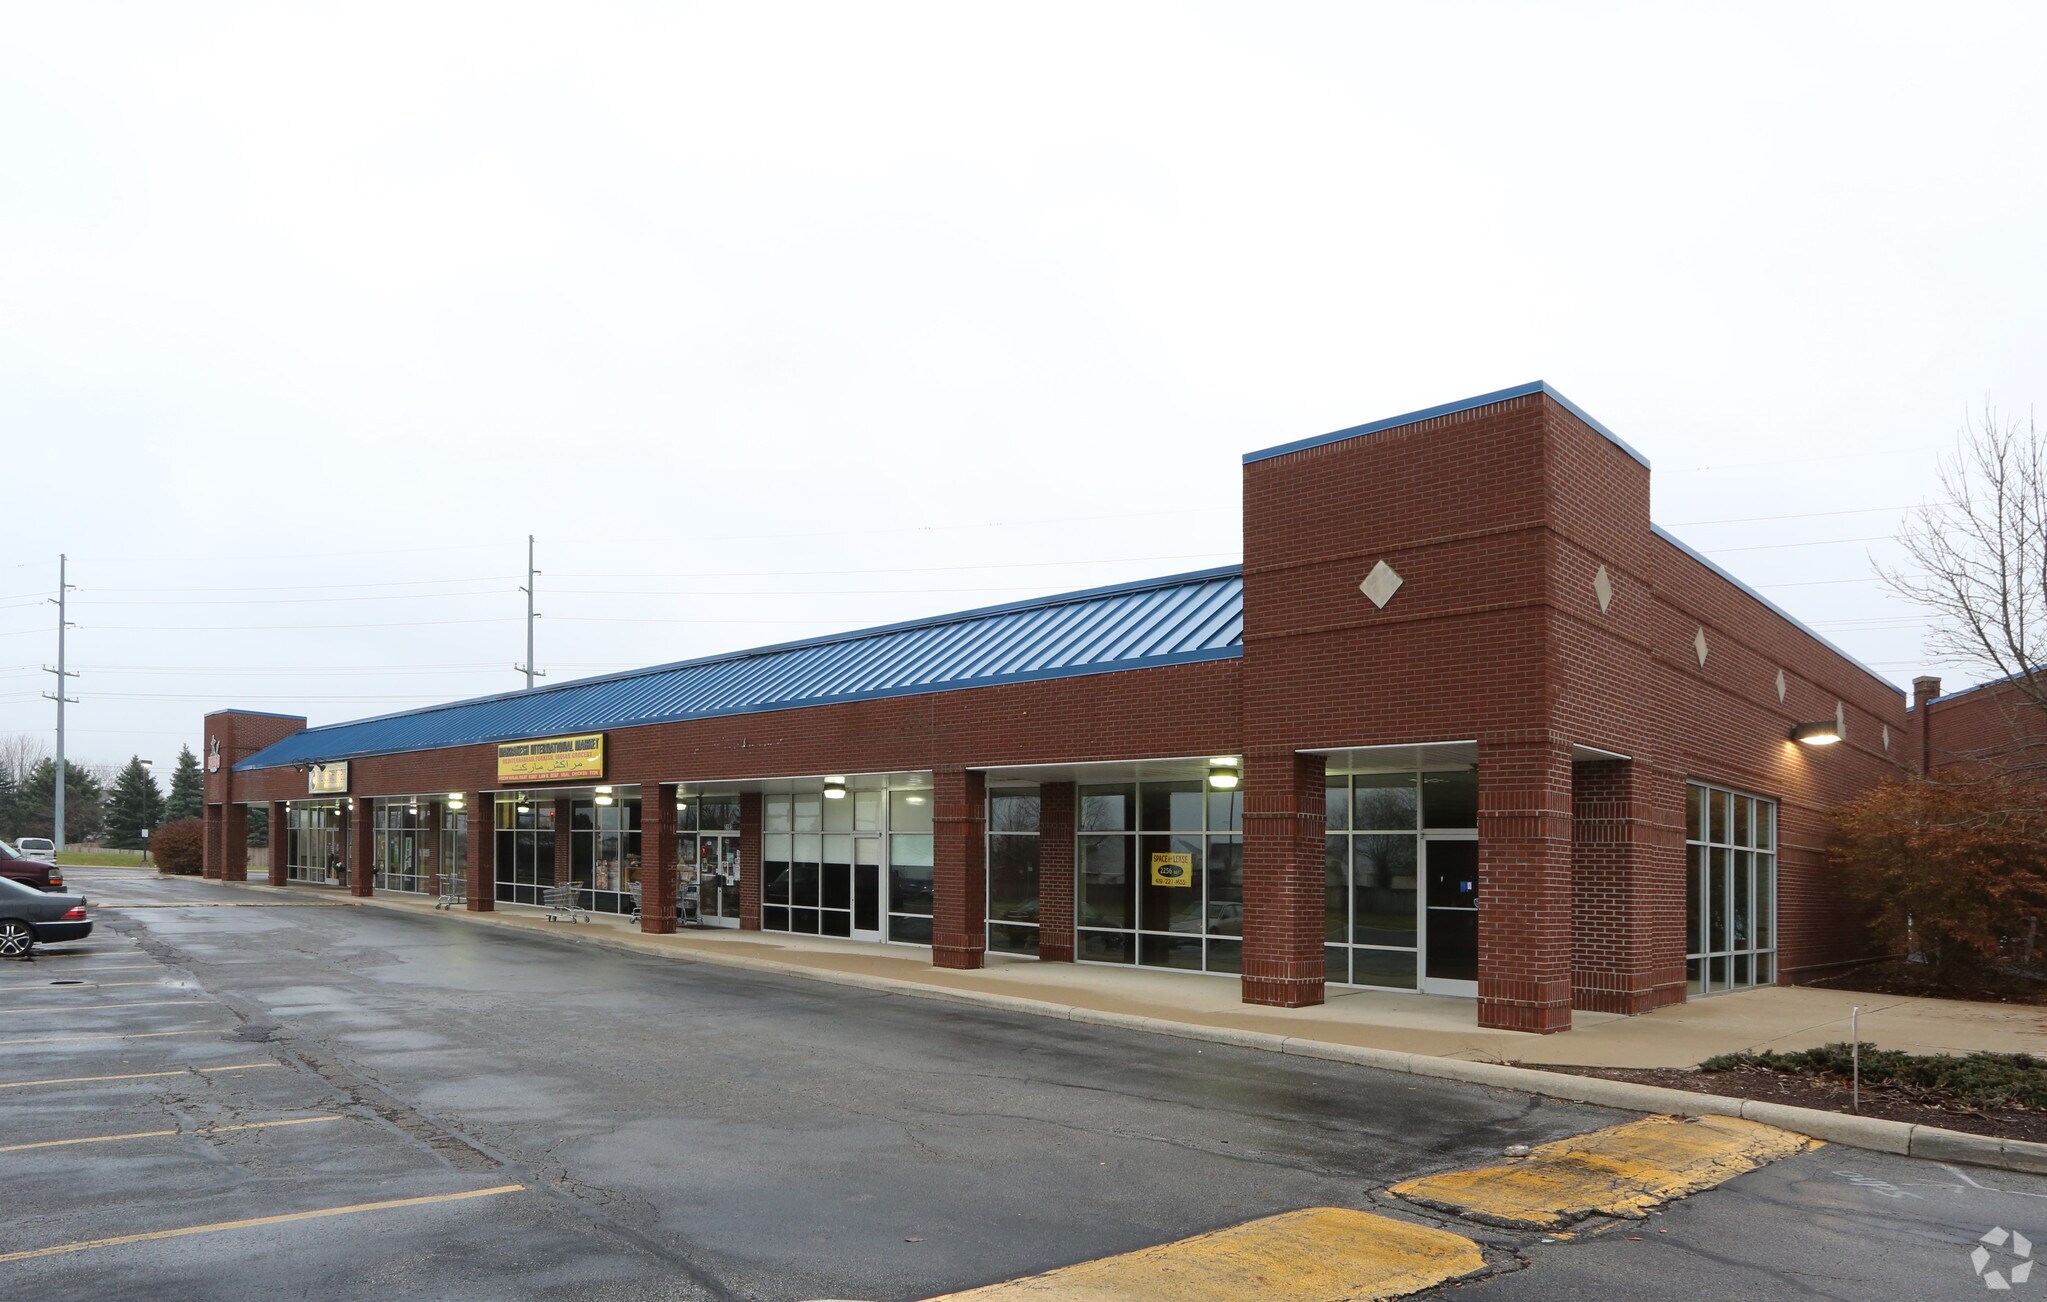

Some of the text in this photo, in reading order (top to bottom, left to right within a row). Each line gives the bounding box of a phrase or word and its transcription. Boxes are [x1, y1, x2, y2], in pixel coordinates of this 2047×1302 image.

[530, 741, 574, 755] INTERNATIONAL
[575, 738, 599, 751] MARKET
[1153, 855, 1168, 863] SPACE
[1173, 855, 1188, 863] LEASE
